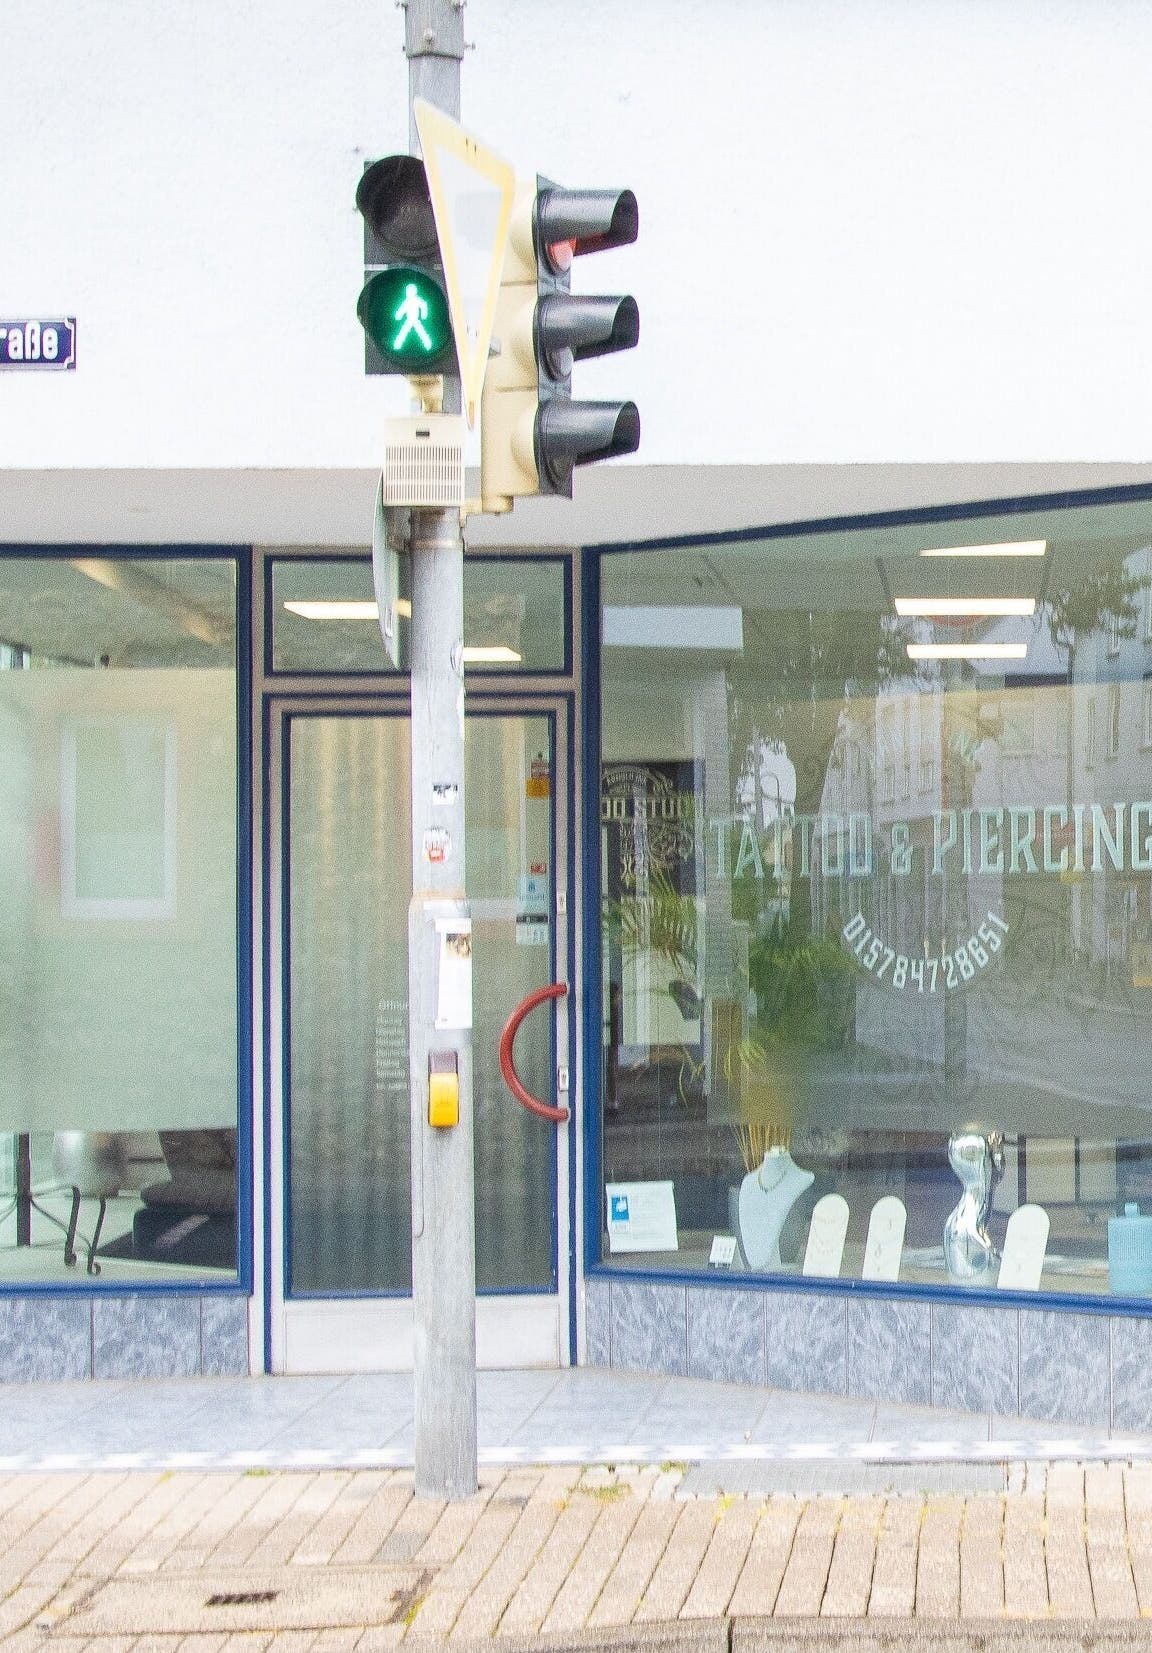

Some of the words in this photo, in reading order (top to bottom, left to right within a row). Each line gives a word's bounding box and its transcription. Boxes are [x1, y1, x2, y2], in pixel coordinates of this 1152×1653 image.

[709, 811, 873, 878] TATTOO
[891, 819, 913, 876] &
[843, 910, 1009, 993] 015784728651
